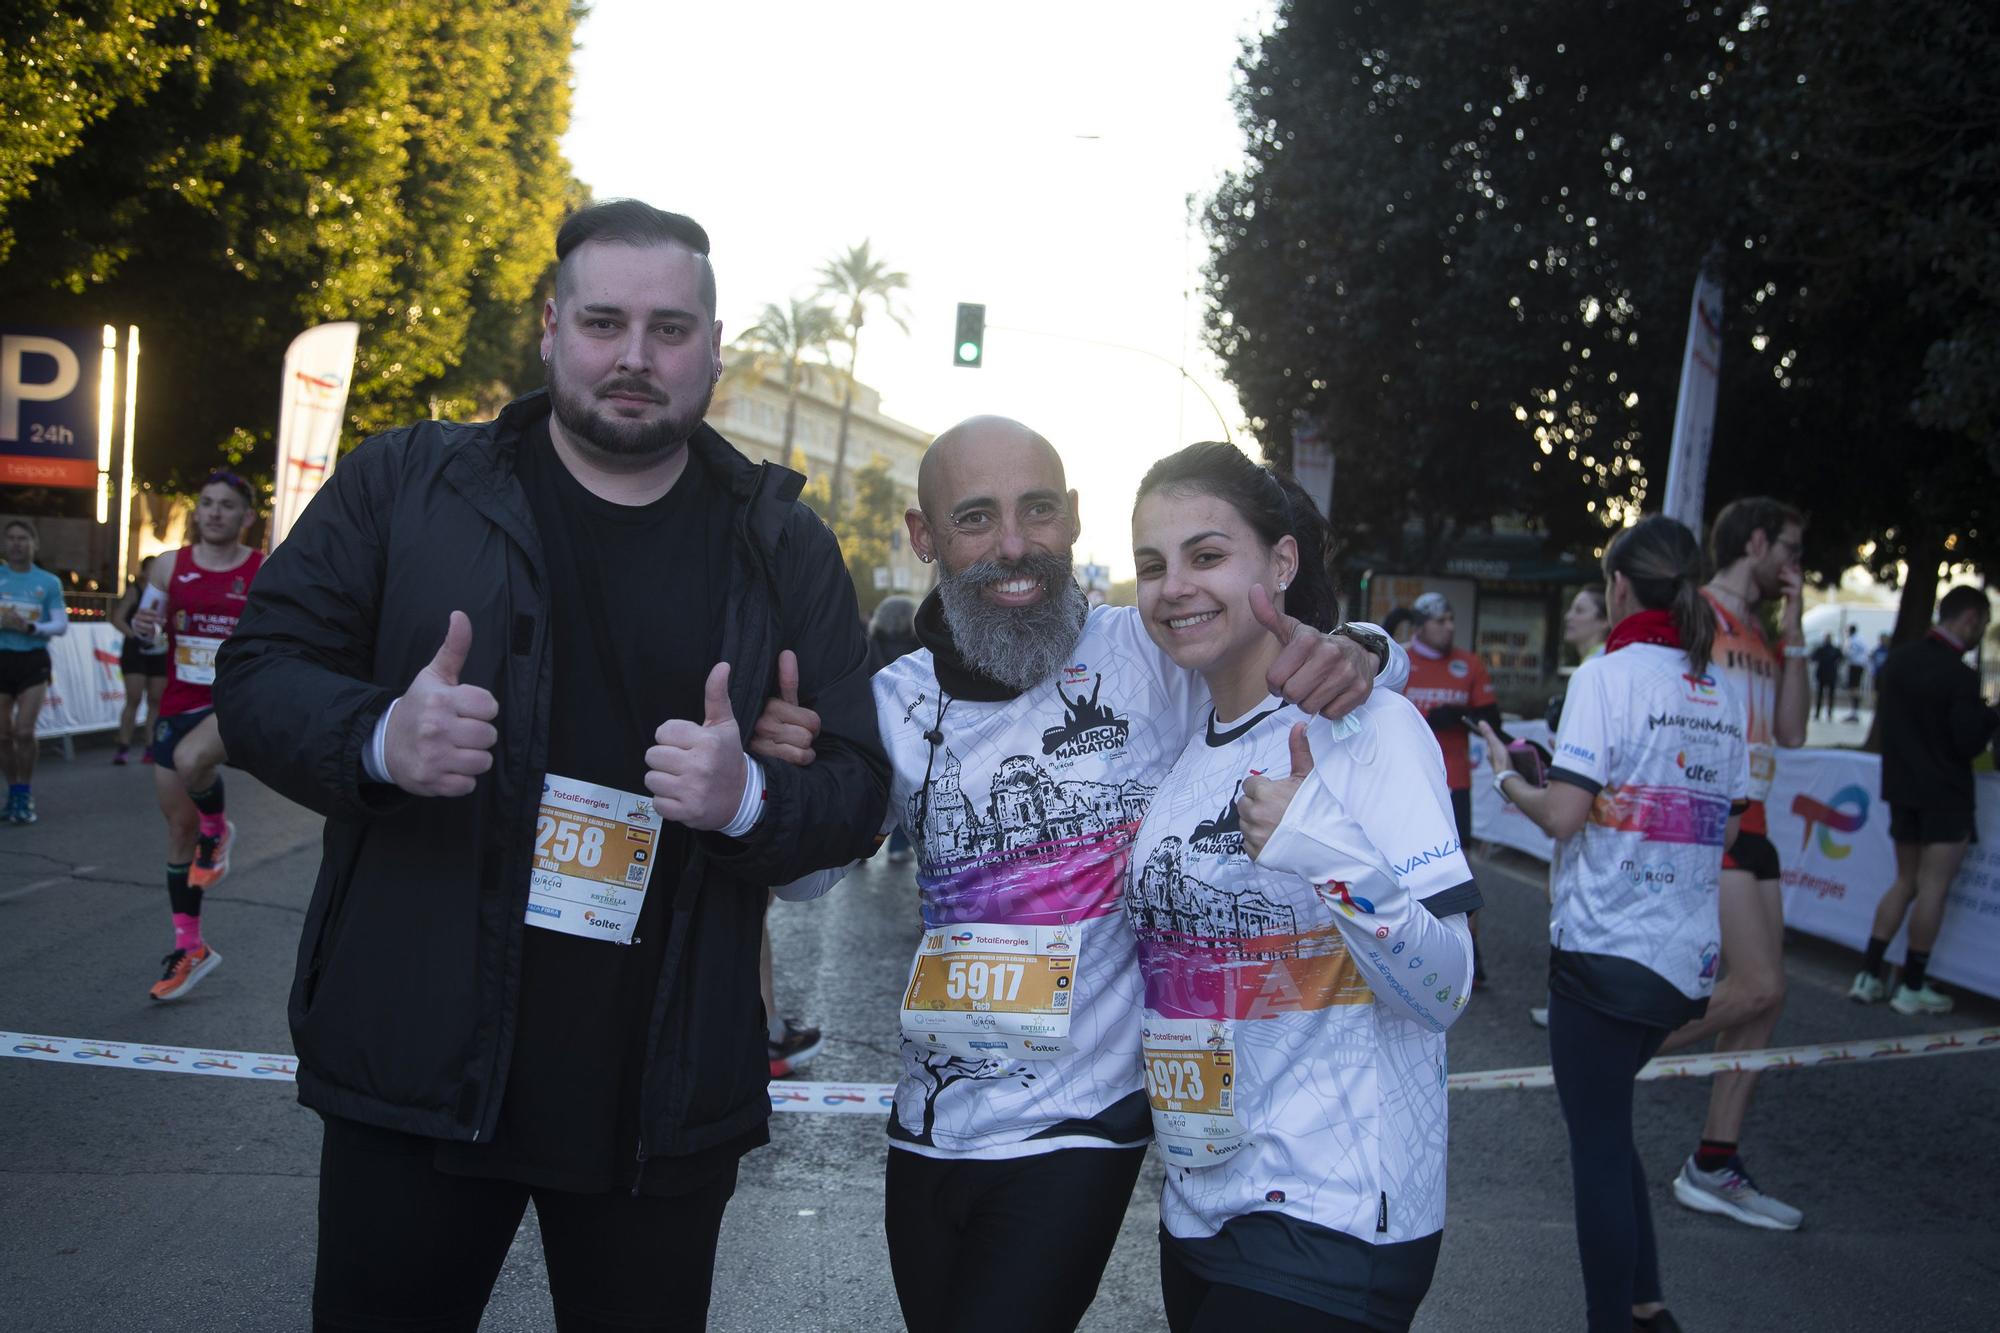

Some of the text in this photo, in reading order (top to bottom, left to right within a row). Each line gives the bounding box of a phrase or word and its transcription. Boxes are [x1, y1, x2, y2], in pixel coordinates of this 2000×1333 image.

[0, 334, 80, 442] P
[30, 424, 74, 446] 24h
[1068, 727, 1126, 747] MURCIA
[552, 789, 610, 810] TotalEnergies
[589, 917, 621, 931] soltec
[975, 936, 1029, 947] TotalEnergies
[946, 961, 1025, 1002] 5917
[1020, 1025, 1056, 1033] ESTRELLA
[1152, 1032, 1192, 1043] TotalEnergies
[1030, 1043, 1061, 1053] soltec
